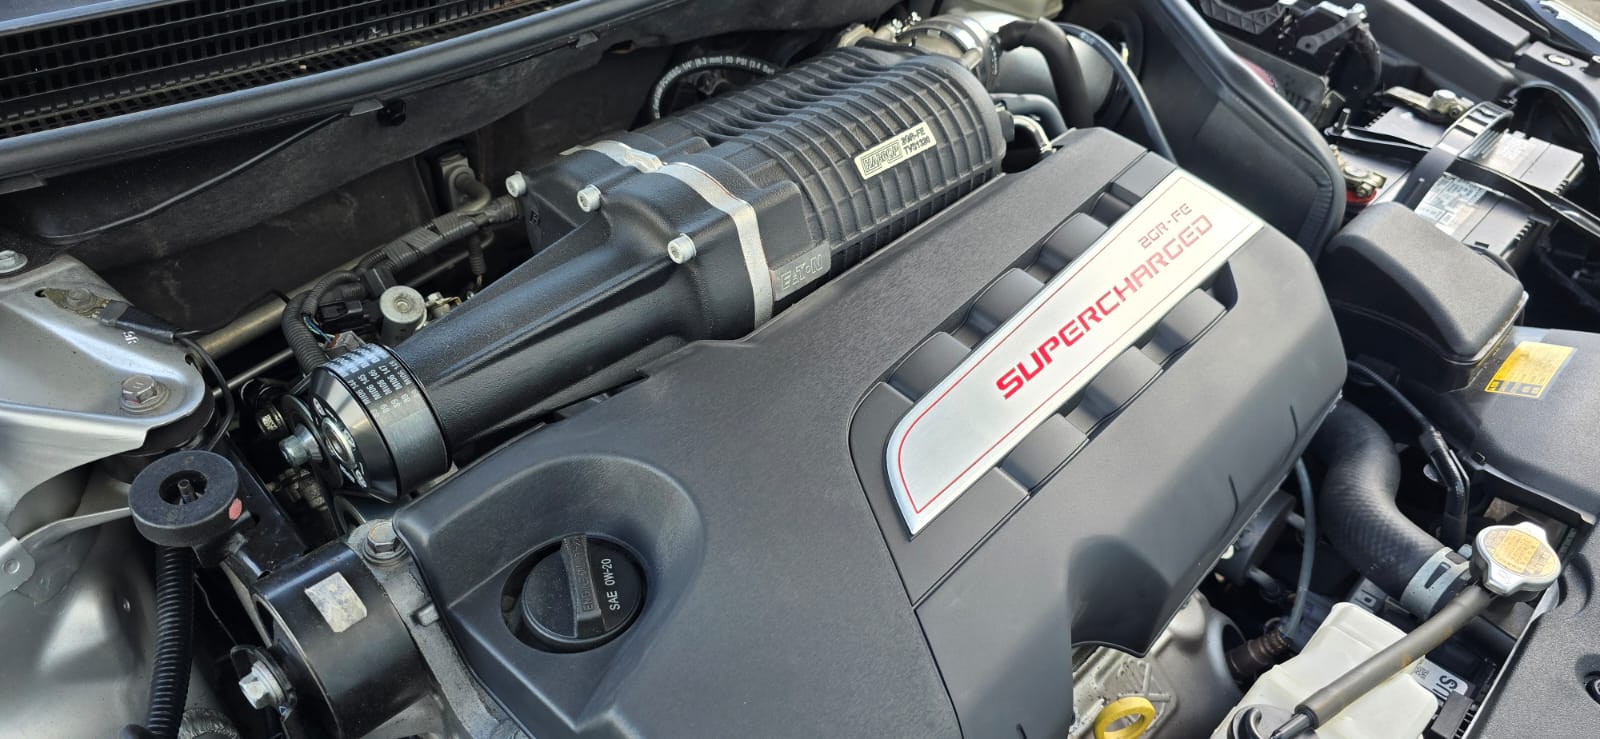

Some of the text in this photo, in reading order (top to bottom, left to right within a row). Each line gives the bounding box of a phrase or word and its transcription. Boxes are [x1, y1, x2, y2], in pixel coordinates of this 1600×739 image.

[995, 214, 1214, 400] SUPERCHARGED
[600, 558, 621, 611] SAE 0W-20
